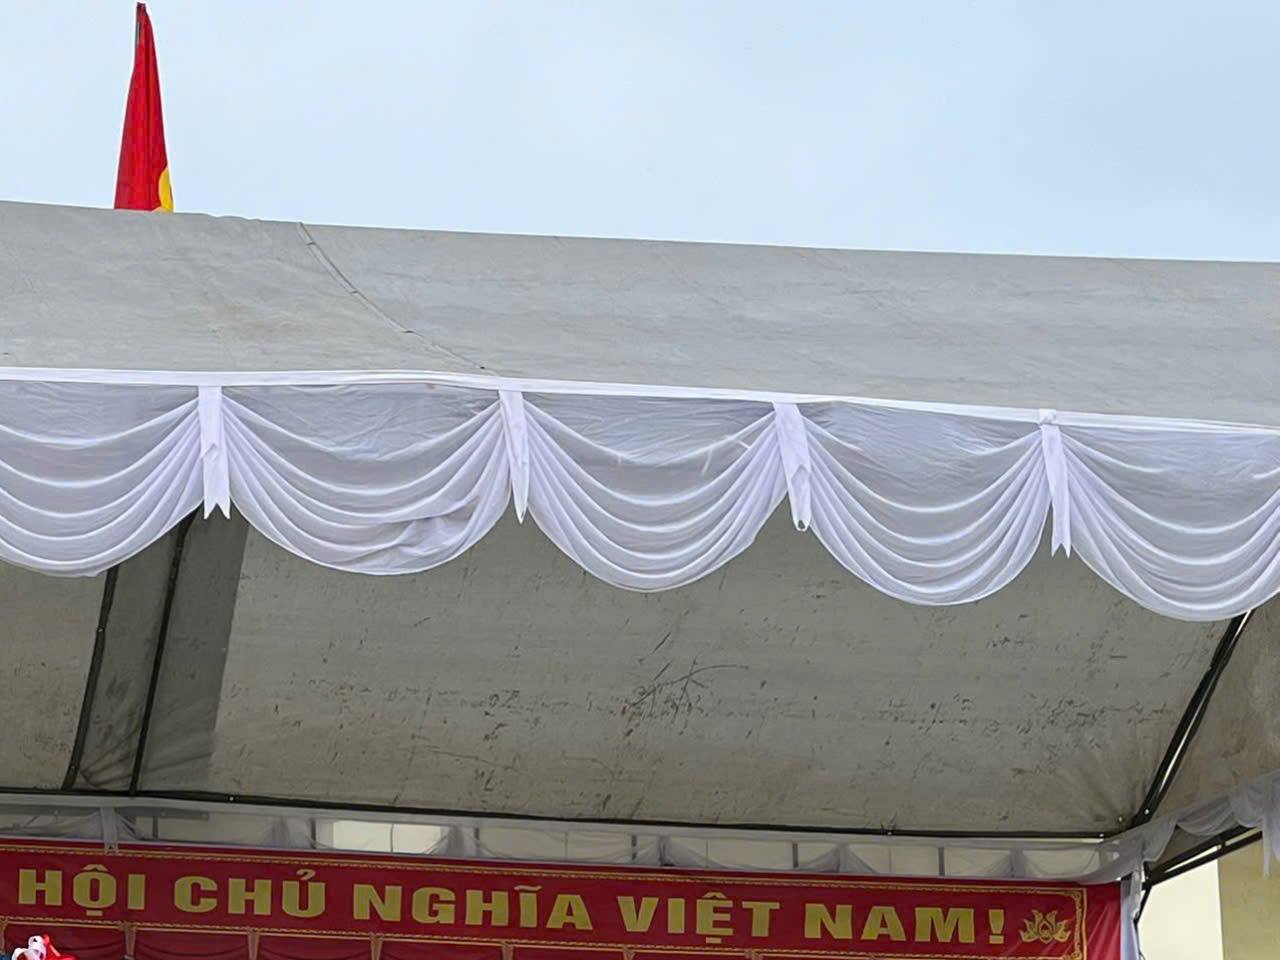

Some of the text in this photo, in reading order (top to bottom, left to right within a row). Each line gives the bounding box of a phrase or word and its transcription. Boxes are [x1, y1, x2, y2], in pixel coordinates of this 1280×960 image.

[19, 864, 146, 916] HỘI
[174, 869, 327, 919] CHỦ
[353, 883, 594, 933] NGHĨA
[617, 892, 780, 945] VIỆT
[803, 903, 1005, 945] NAM!
